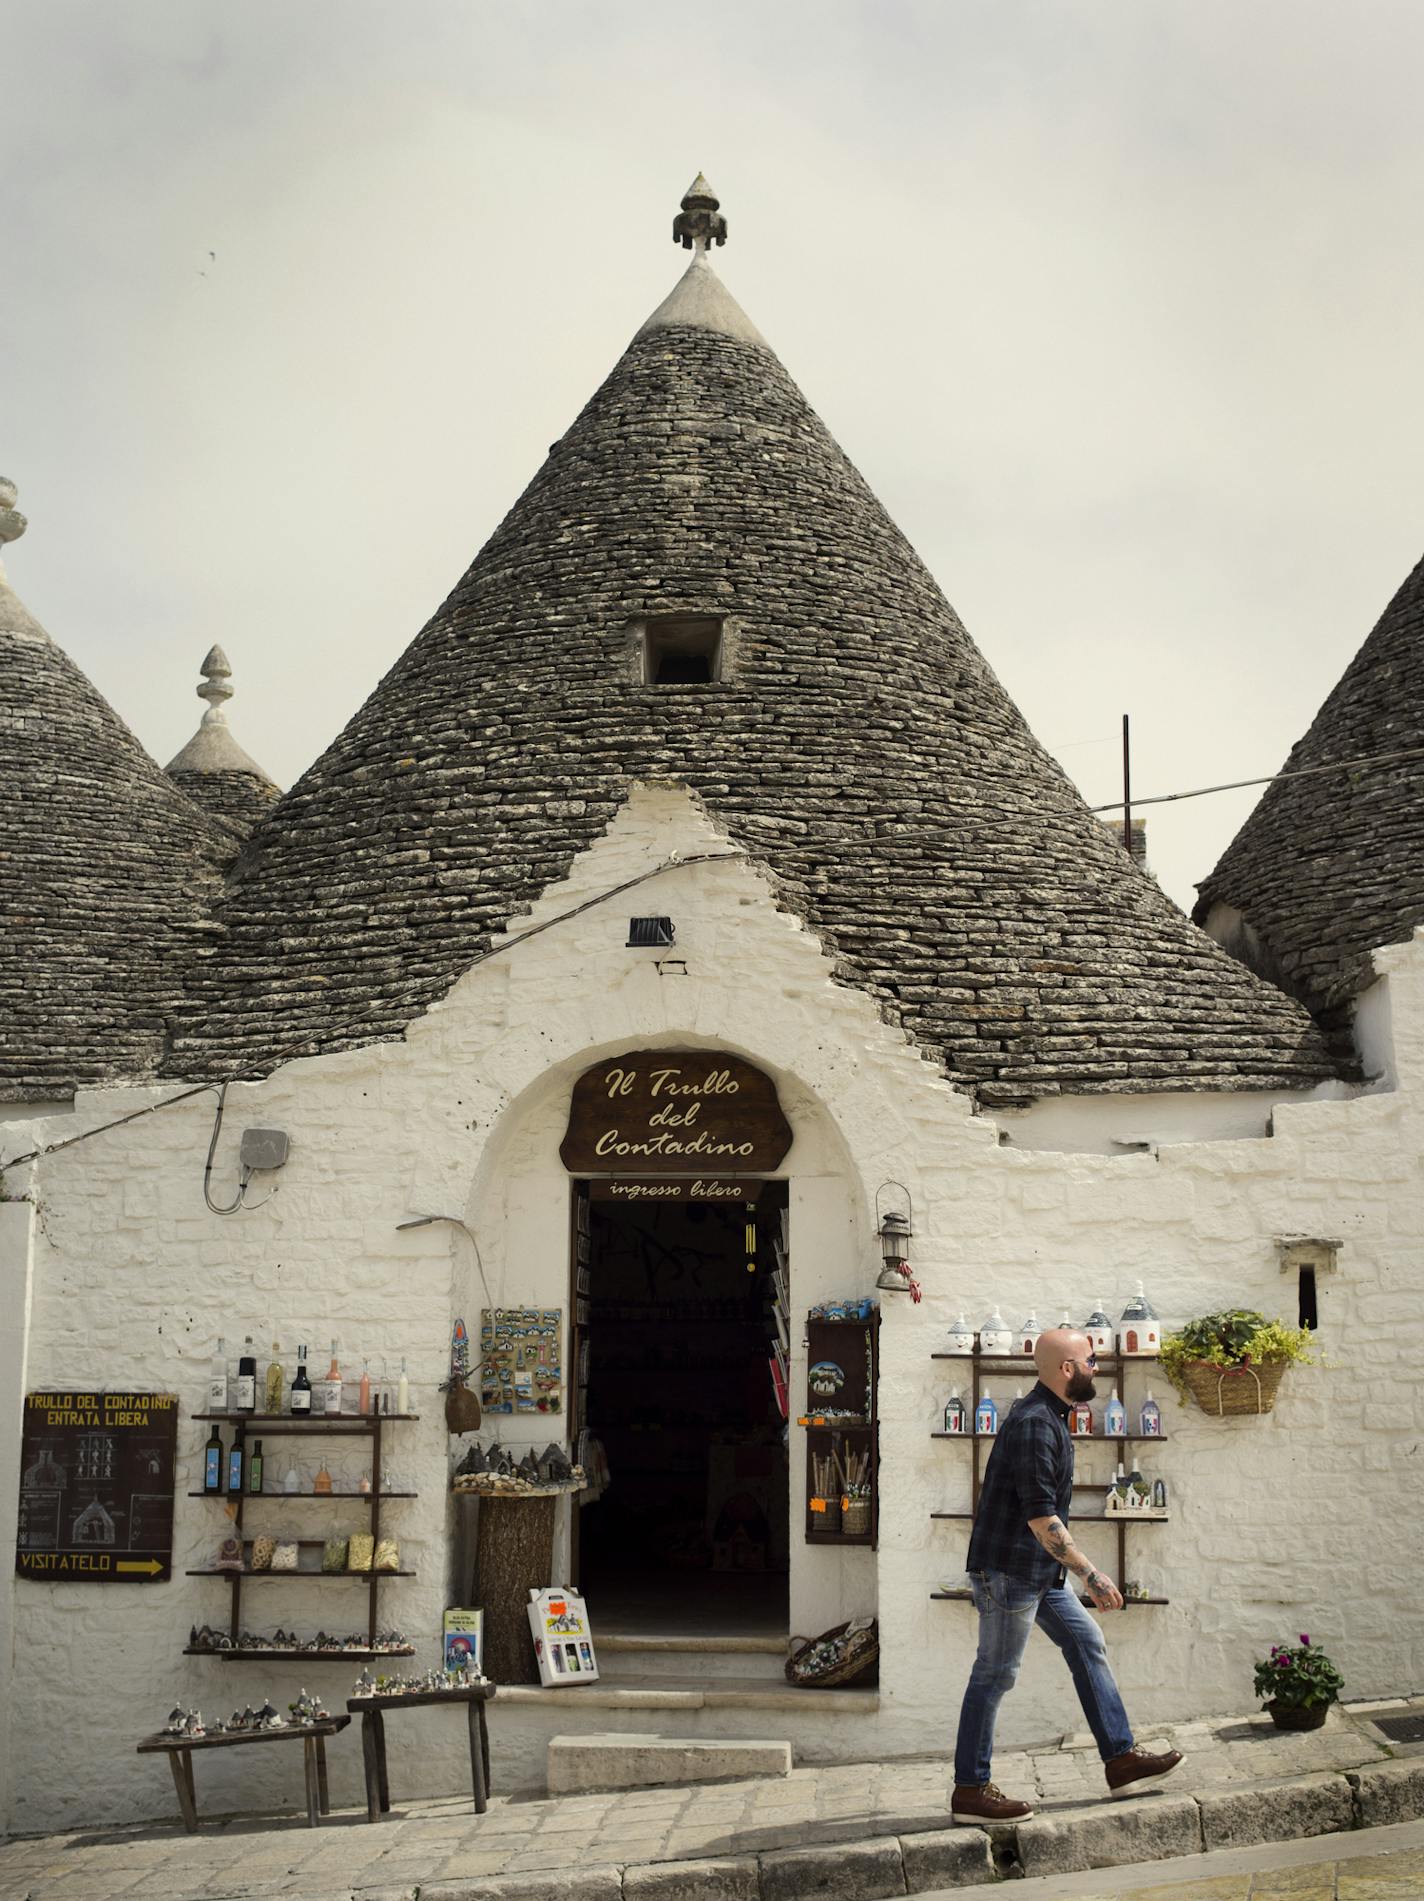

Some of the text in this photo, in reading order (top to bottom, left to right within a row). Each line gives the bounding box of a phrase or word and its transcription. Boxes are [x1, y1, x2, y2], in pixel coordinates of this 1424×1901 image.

[605, 1068, 740, 1098] Il Trullo
[648, 1102, 701, 1127] del
[595, 1129, 754, 1156] Contadino
[609, 1180, 742, 1199] ingresso libero
[28, 1395, 72, 1409] TRULLO
[77, 1396, 99, 1409] DEL
[47, 1411, 149, 1426] ENTRATA LIBERA
[21, 1555, 110, 1571] VISITATELO
